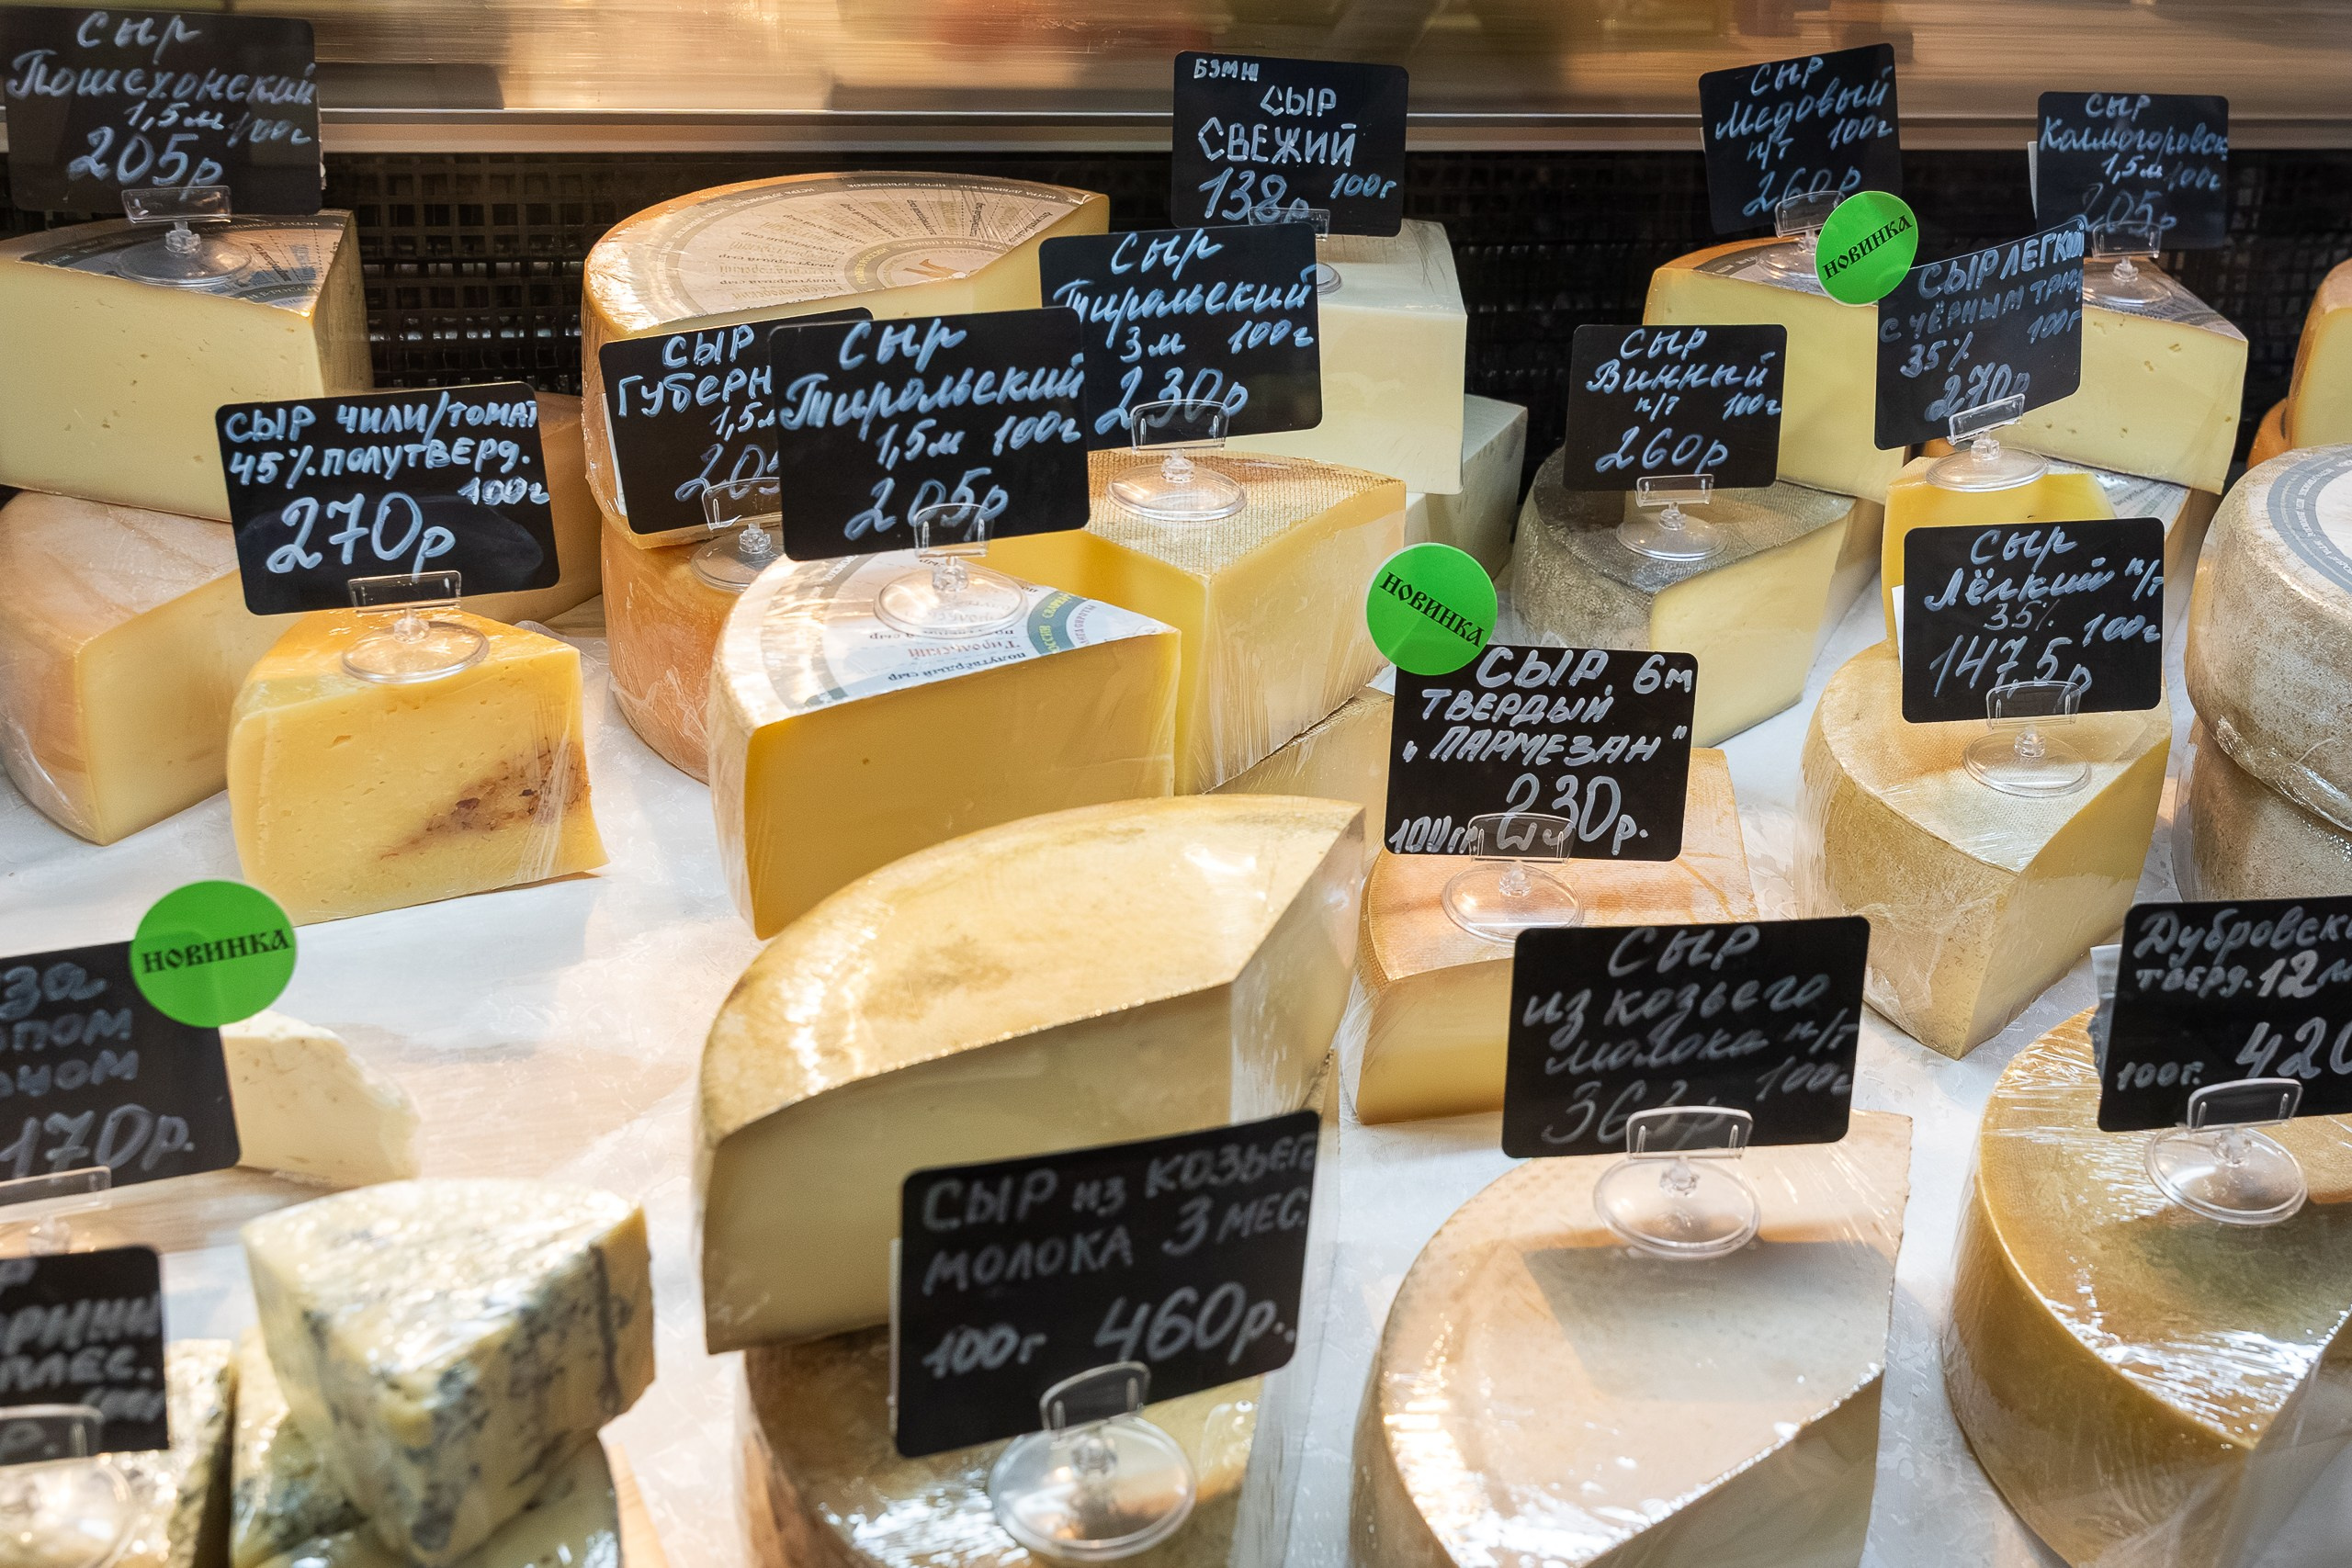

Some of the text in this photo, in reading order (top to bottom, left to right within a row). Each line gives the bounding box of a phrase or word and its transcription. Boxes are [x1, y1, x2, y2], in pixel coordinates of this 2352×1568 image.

[77, 11, 202, 65] Сыр
[6, 49, 317, 106] Пошехонский
[1260, 85, 1338, 118] СЫР
[1197, 117, 1357, 167] СВЕЖИЙ
[1330, 172, 1397, 199] 100г
[1111, 228, 1225, 281] Сыр
[1822, 214, 1913, 280] НОВИНКА
[1918, 249, 1999, 299] СЫР
[662, 324, 755, 368] СЫР
[839, 318, 967, 374] Сыр
[1620, 328, 1708, 361] Сыр
[1900, 331, 1974, 378] 35%
[780, 352, 1085, 442] Тирольский
[1585, 351, 1776, 393] Винный
[225, 405, 316, 443] СЫР
[992, 412, 1081, 456] 100г
[1595, 425, 1729, 476] 260р
[266, 491, 457, 582] 270р
[1970, 525, 2078, 573] Сыр
[1379, 571, 1486, 648] НОВИНКА
[1476, 647, 1609, 689] СЫР
[1421, 684, 1613, 727] ТВЕРДЫЙ
[141, 929, 292, 975] НОВИНКА
[1608, 925, 1760, 978] Сыр
[2133, 908, 2352, 970] Дубровск
[1522, 988, 1592, 1052] из
[922, 1168, 1059, 1232] СЫР
[922, 1225, 1134, 1296] МОЛОКА
[1161, 1196, 1214, 1256] 3
[922, 1324, 1047, 1378] 100г
